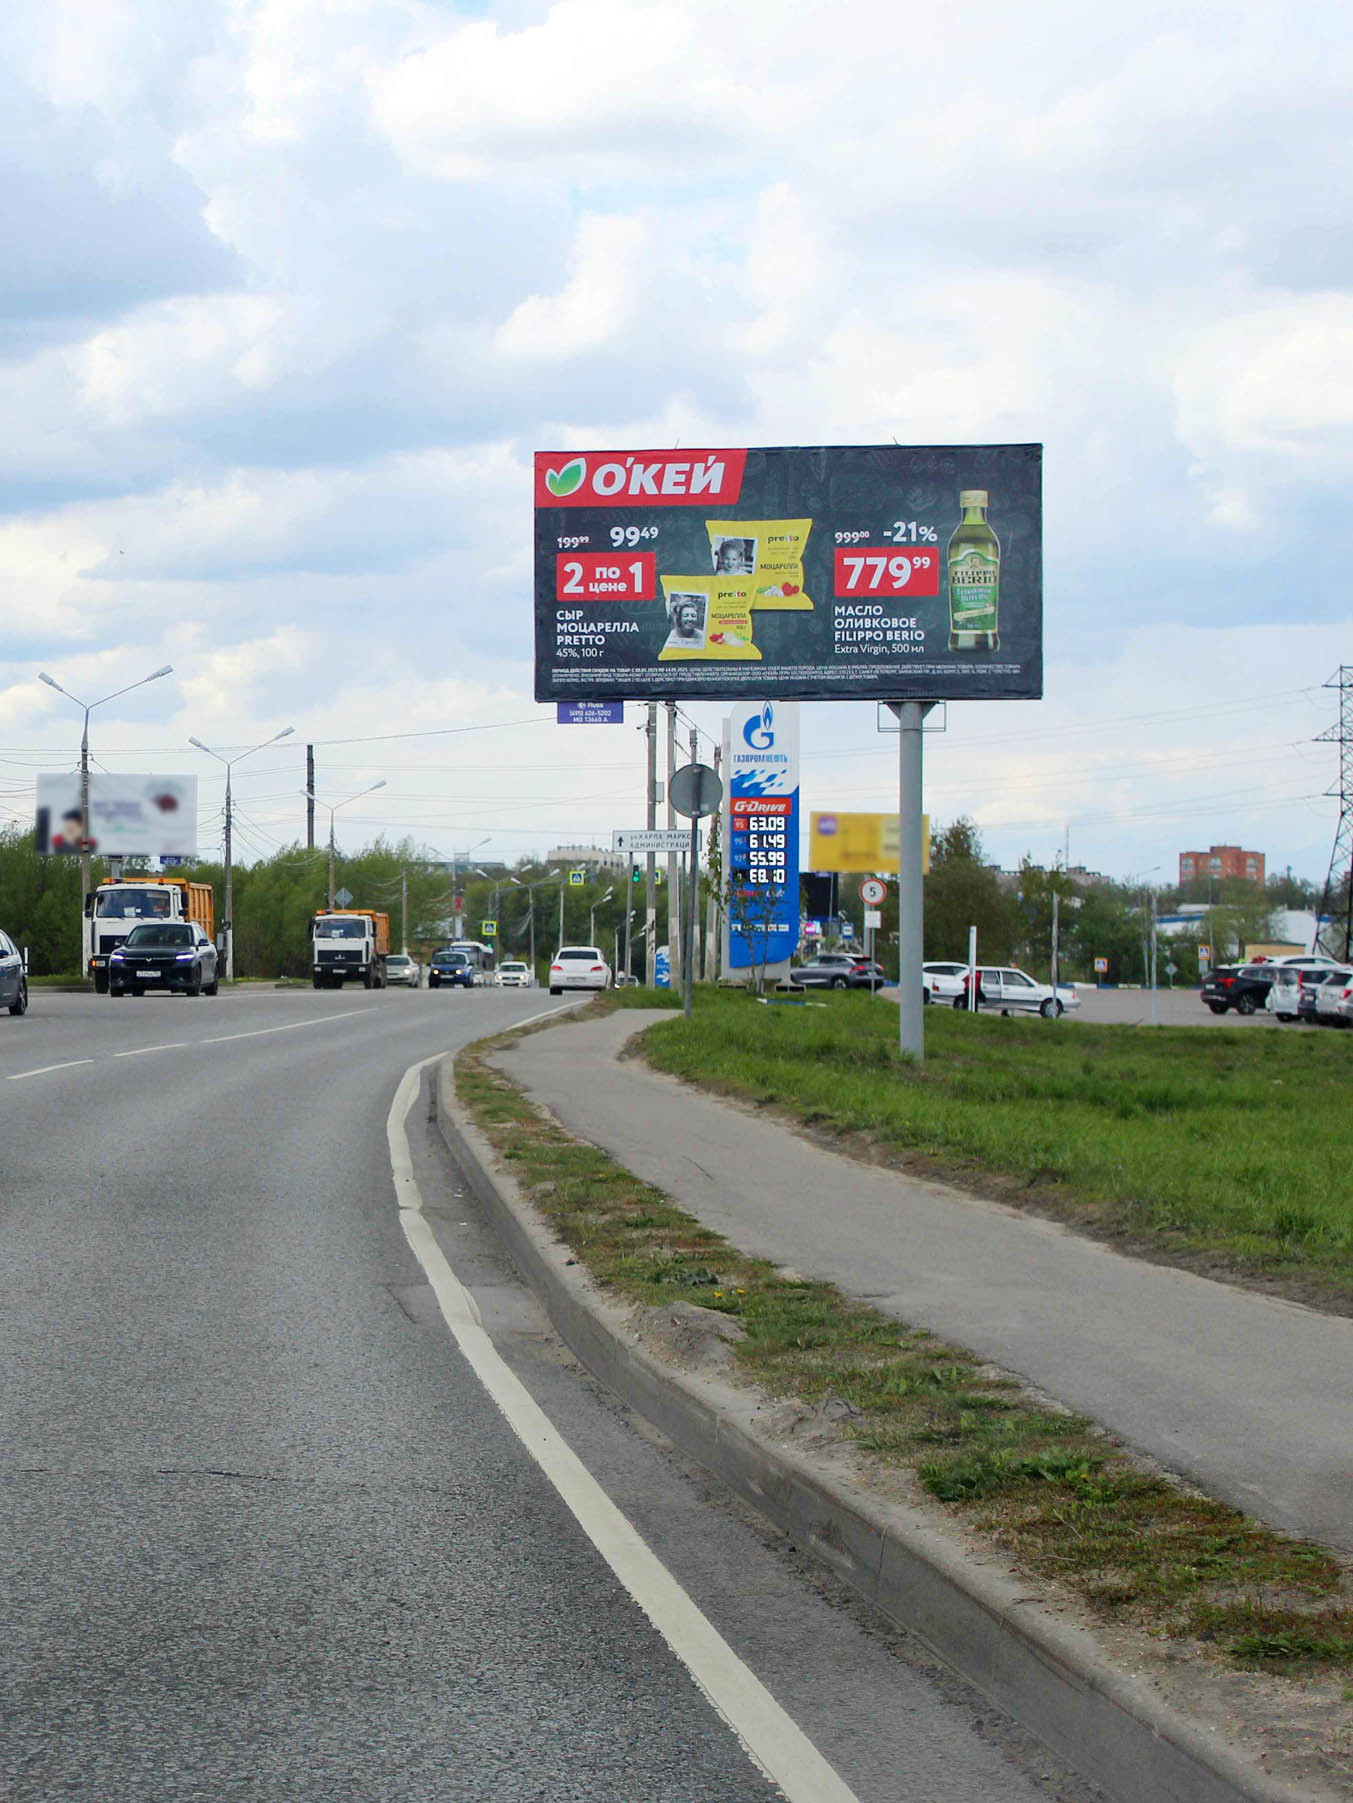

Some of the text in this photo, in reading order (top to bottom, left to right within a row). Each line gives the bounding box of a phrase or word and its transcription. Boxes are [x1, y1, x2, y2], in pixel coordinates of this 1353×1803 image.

[883, 521, 938, 542] -21%
[563, 562, 643, 594] 2 по цене 1
[556, 610, 584, 620] СЫР
[834, 606, 883, 616] МАСЛО
[556, 622, 639, 634] МОЦАРЕЛЛА
[834, 618, 917, 629] ОЛИВКОВОЕ
[556, 635, 605, 645] PRETTO
[834, 630, 925, 641] FILIPPO BERIO
[581, 648, 597, 657] 100
[834, 645, 858, 653] Extra
[860, 644, 890, 655] Virgin,
[891, 645, 909, 653] 500
[749, 817, 785, 831] 63.09
[630, 841, 690, 849] АДМИНИСТРАЦИ
[749, 851, 785, 866] 55.99
[869, 887, 876, 897] 5
